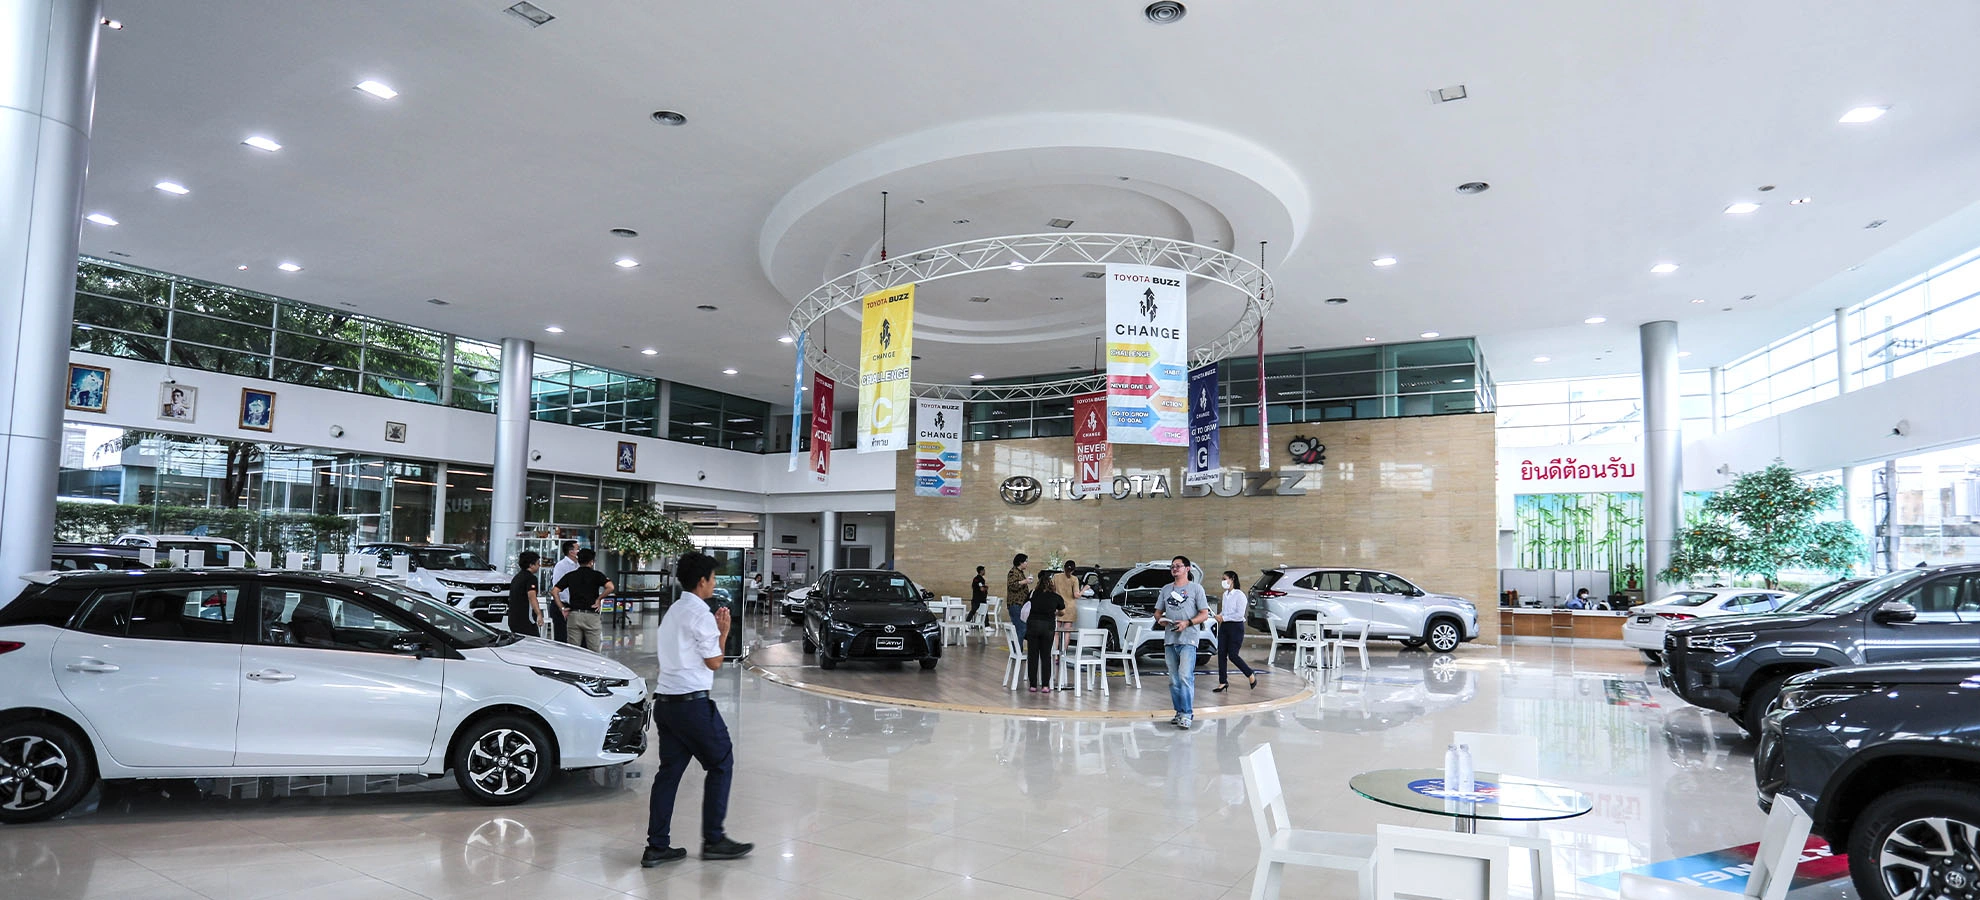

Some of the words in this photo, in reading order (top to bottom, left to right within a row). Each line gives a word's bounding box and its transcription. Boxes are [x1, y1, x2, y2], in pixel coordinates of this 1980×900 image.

[1114, 273, 1150, 283] TOYOTA
[1152, 277, 1180, 287] BUZZ
[866, 298, 888, 309] TOYOTA
[889, 293, 909, 304] BUZZ
[1115, 324, 1180, 340] CHANGE
[872, 351, 896, 361] CHANGE
[1110, 349, 1150, 357] CHALLENGE
[861, 368, 909, 386] CHALLENGE
[872, 397, 892, 429] C
[814, 430, 832, 443] ACTION
[920, 430, 958, 439] CHANGE
[1078, 443, 1106, 454] NEVER
[817, 450, 825, 470] A
[1078, 454, 1094, 462] GIVE
[1197, 446, 1208, 469] G
[1083, 461, 1099, 481] N
[1521, 457, 1635, 480] ยินดีต้อนรับ
[1048, 474, 1171, 500] TOOTA
